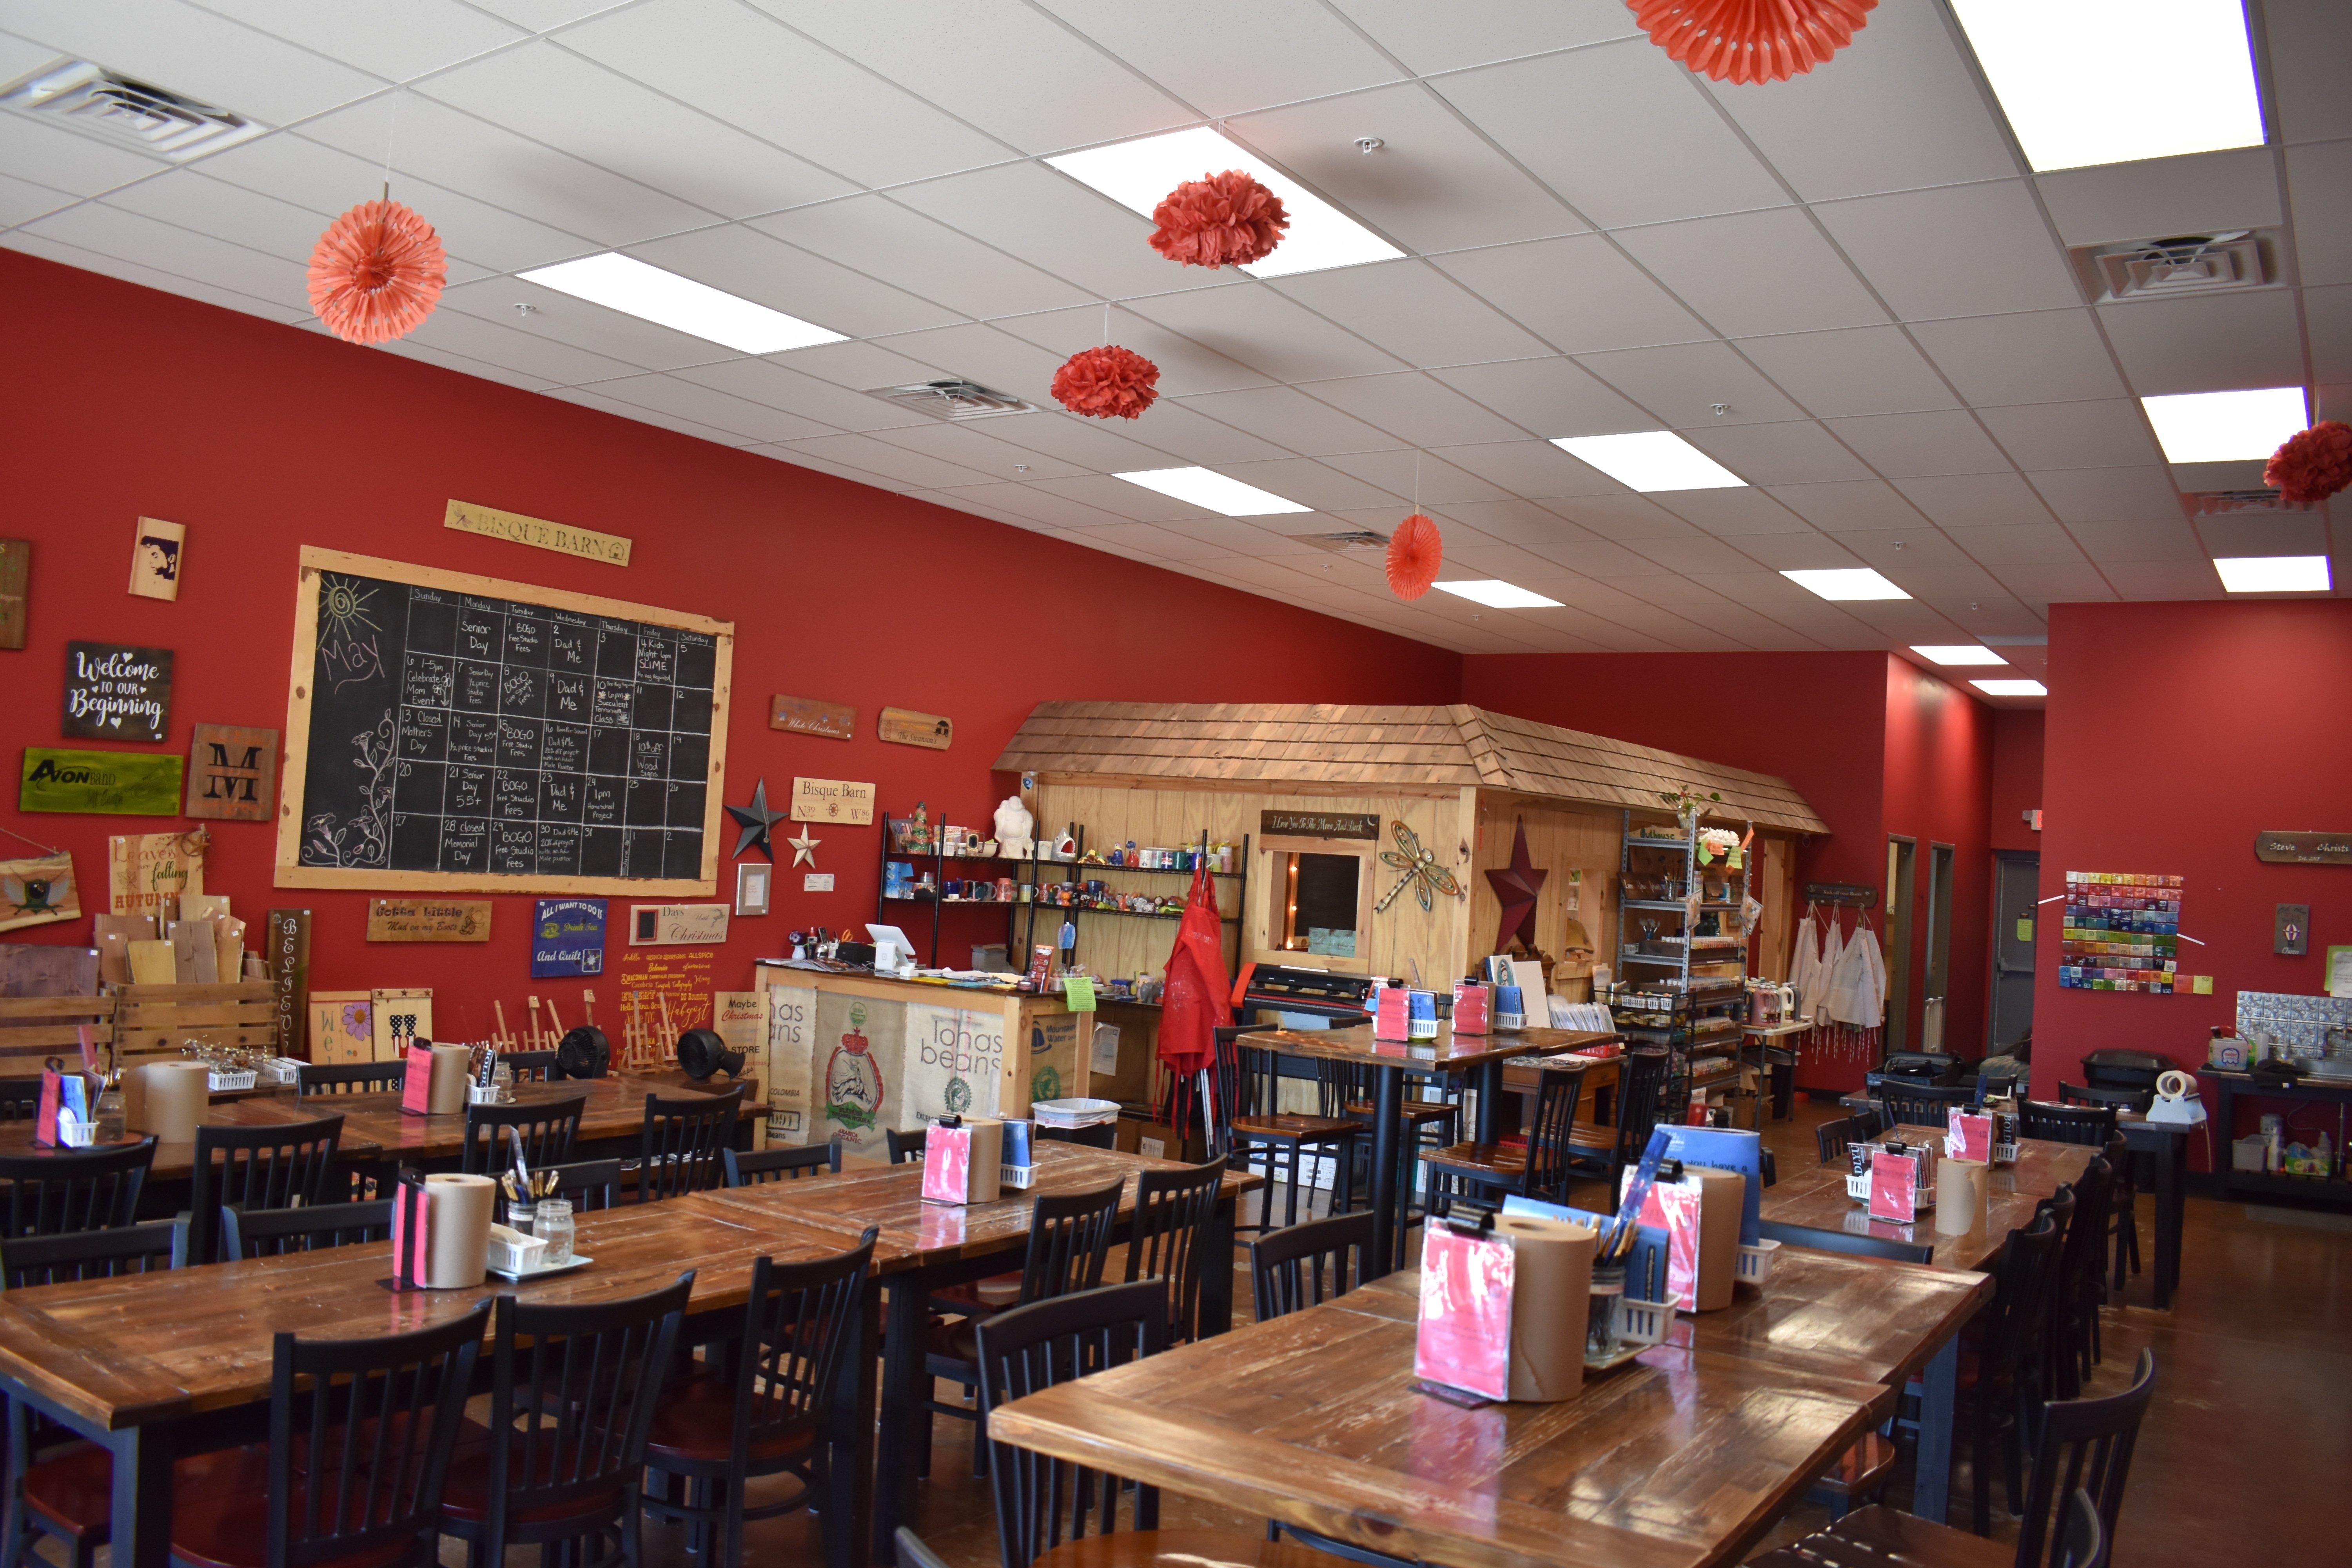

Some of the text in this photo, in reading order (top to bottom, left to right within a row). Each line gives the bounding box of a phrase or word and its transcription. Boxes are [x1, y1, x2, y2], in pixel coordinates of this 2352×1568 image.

[477, 514, 606, 555] BISQUE BARN
[415, 589, 708, 644] Sunday Monday Tuesday Wednesday Thursday Friday Saturday
[461, 621, 491, 634] Senior
[517, 623, 536, 634] BOGO
[553, 625, 559, 634] 2
[470, 636, 488, 655] Day
[516, 644, 531, 652] Fees
[555, 639, 573, 648] Dad
[641, 639, 664, 648] 4 Kids
[567, 651, 582, 663] Me
[639, 649, 658, 661] Night
[77, 652, 159, 681] Welcome
[321, 634, 385, 694] May
[639, 660, 667, 670] SLIME
[408, 671, 441, 682] Celebrate
[101, 681, 138, 695] TO OUR
[407, 684, 425, 695] Mom
[557, 680, 577, 694] Dad
[597, 681, 606, 689] 10
[412, 695, 435, 705] Event
[560, 697, 577, 710] Me
[597, 699, 628, 708] Succulent
[70, 689, 164, 730] Beginning
[401, 709, 441, 723] 13 Closed
[594, 715, 613, 723] Class
[787, 716, 840, 734] White Christmas
[402, 726, 432, 737] Mothers
[909, 733, 937, 744] Swanson's
[411, 739, 427, 753] Day
[637, 759, 658, 770] Wood
[203, 742, 262, 801] M
[450, 766, 485, 780] 21 Senior
[641, 771, 659, 779] Signs
[463, 781, 478, 797] Day
[594, 789, 610, 800] 1pm
[803, 781, 866, 800] Bisque Barn
[456, 796, 482, 807] 55+
[593, 811, 614, 819] Project
[797, 805, 806, 817] N
[445, 820, 456, 832] 28
[445, 837, 478, 848] Memorial
[503, 832, 533, 843] BOGO
[114, 840, 176, 862] Leaves
[495, 845, 534, 855] Free Studio
[2317, 844, 2349, 852] Christi
[455, 851, 471, 865] Day
[507, 857, 524, 868] Fees
[151, 860, 188, 891] falling
[376, 906, 462, 917] Gotta Little
[541, 907, 554, 921] ALL
[588, 905, 597, 915] DO
[597, 908, 602, 919] IS
[663, 907, 684, 918] Days
[387, 922, 408, 931] Mud
[564, 923, 583, 931] Drink
[669, 923, 723, 940] Christmas
[537, 950, 581, 961] And Quilt
[729, 999, 757, 1009] Maybe
[722, 1010, 763, 1022] Christmas
[935, 1020, 1002, 1053] lohas
[770, 1088, 799, 1096] COLOMBIA
